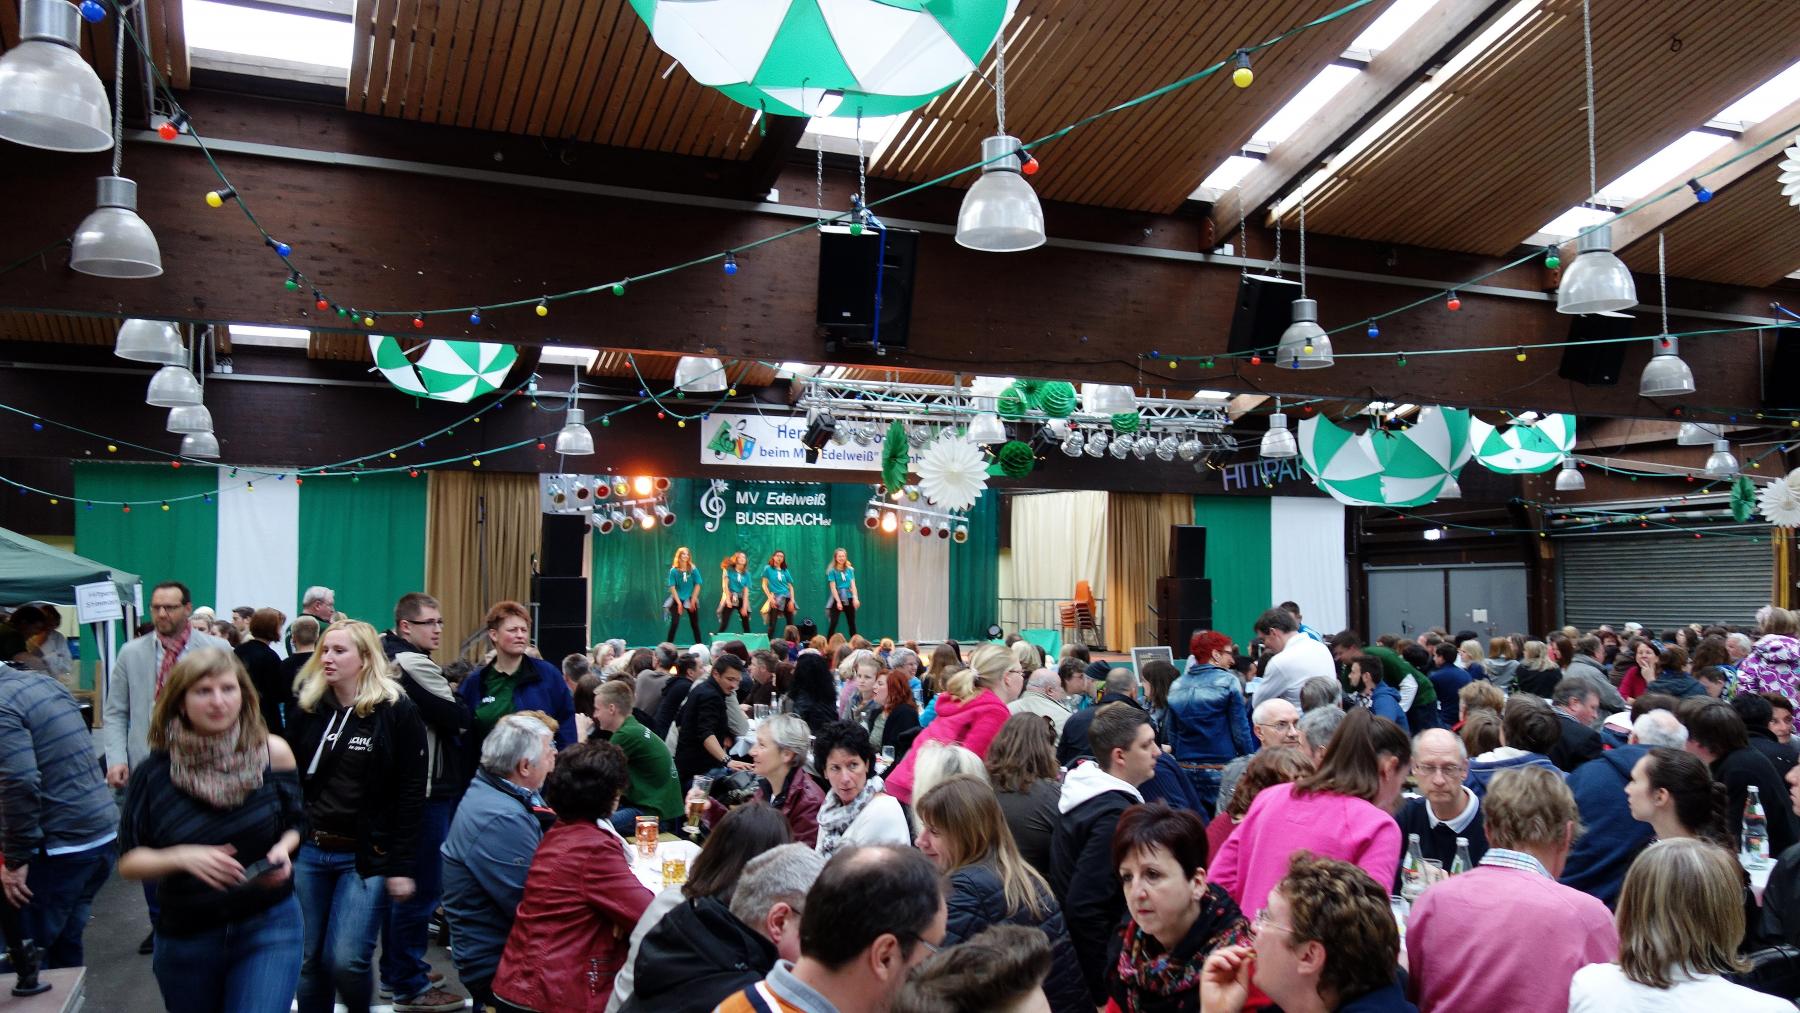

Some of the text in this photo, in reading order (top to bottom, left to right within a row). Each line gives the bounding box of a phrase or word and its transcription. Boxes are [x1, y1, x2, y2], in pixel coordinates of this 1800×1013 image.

[760, 446, 789, 458] beim
[1222, 455, 1304, 491] HITPAR
[735, 491, 826, 506] MV Edelweiß
[735, 511, 823, 526] BUSENBACH
